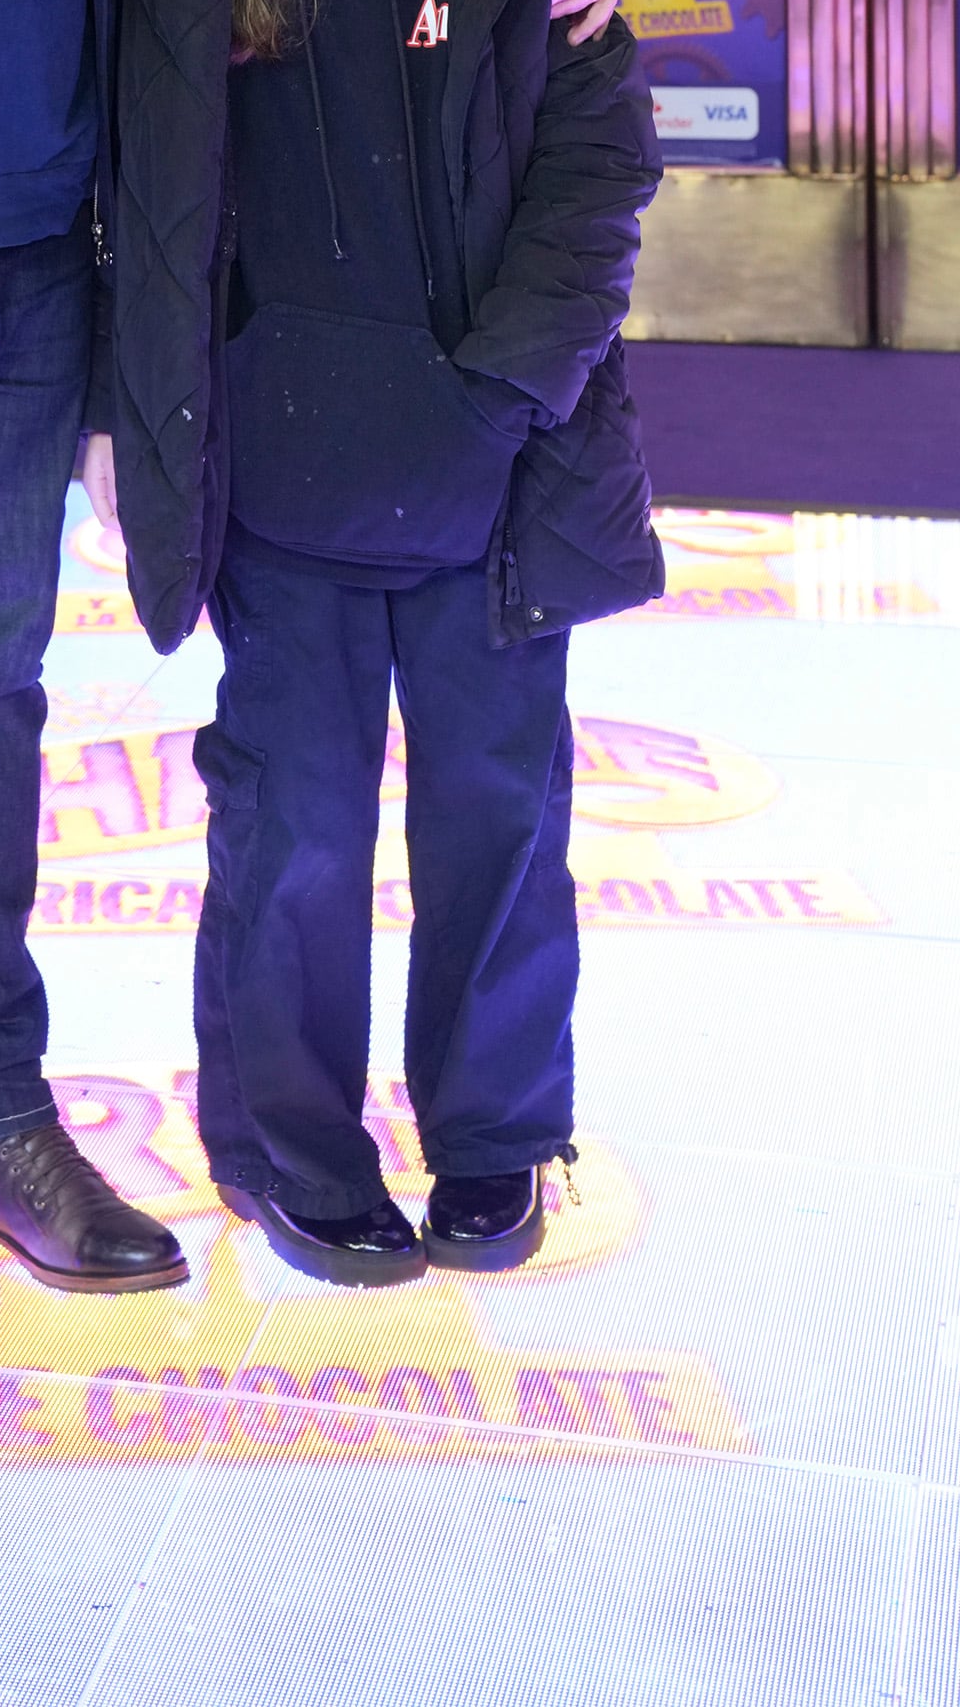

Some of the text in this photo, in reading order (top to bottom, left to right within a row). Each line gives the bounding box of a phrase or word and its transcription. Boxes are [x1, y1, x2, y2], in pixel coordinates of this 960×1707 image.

[641, 6, 725, 32] CHOCOLATE
[703, 104, 748, 121] VISA
[84, 1362, 694, 1450] CHOCOLATE
